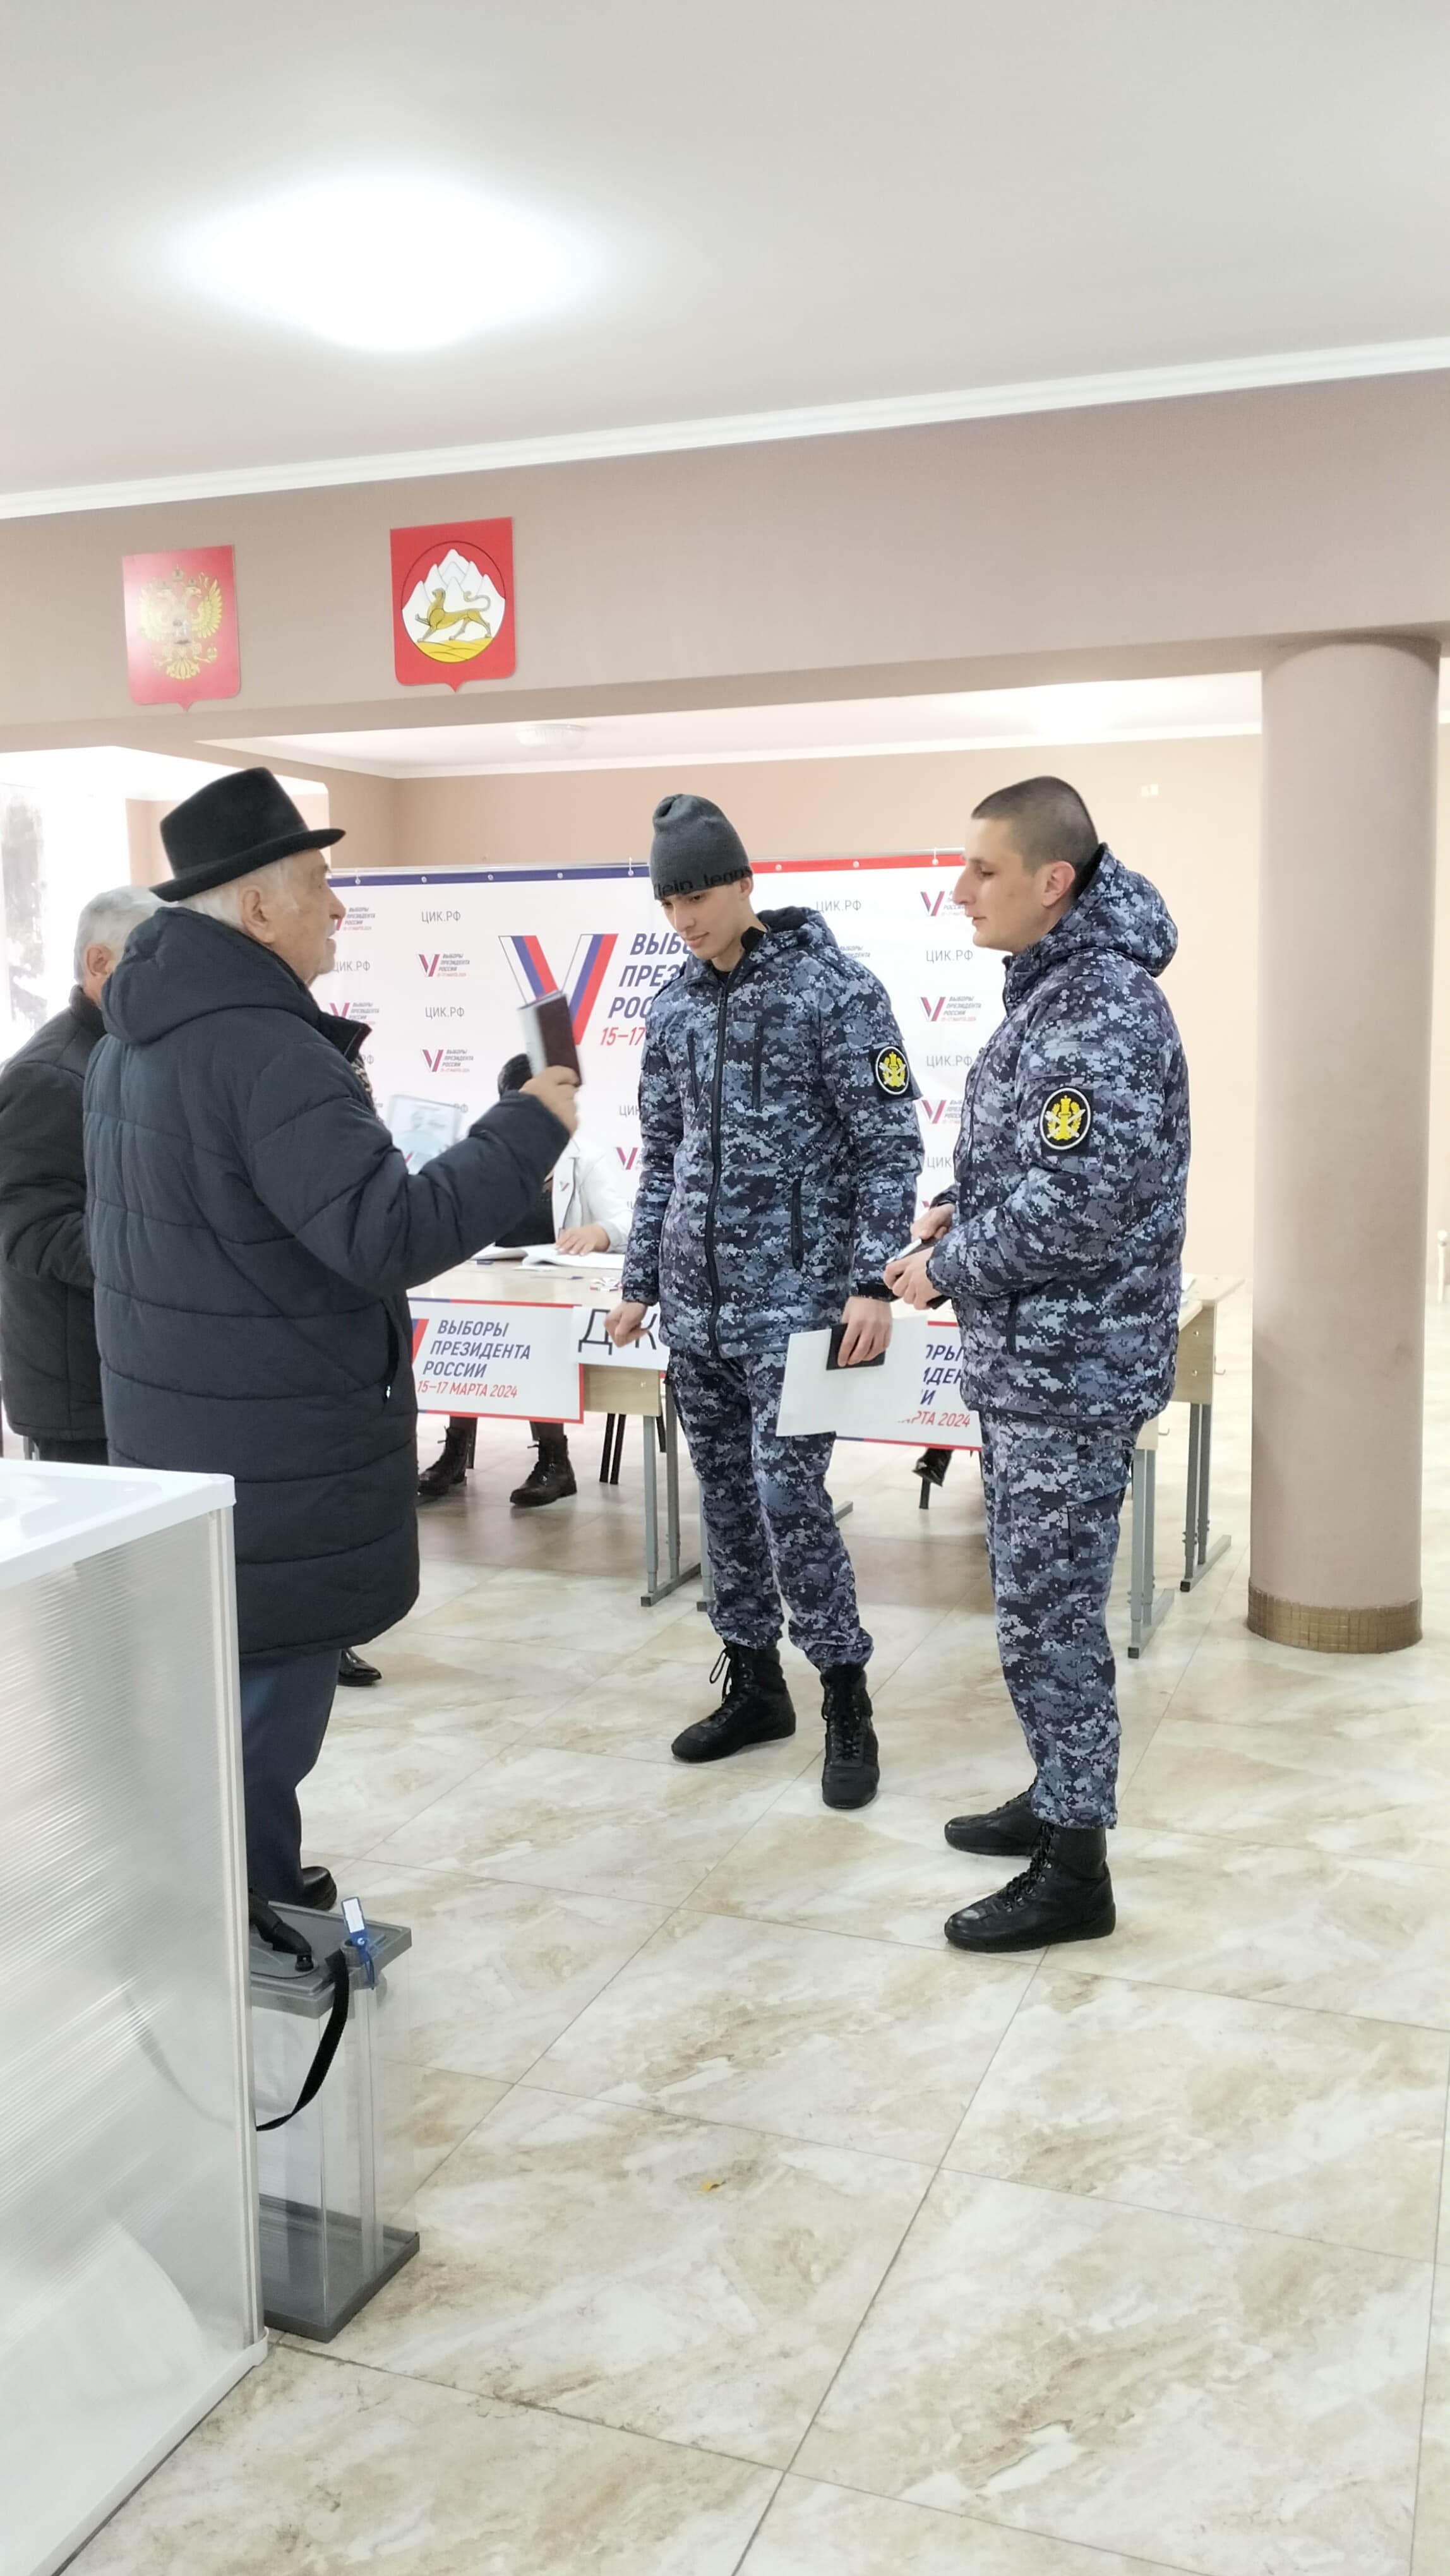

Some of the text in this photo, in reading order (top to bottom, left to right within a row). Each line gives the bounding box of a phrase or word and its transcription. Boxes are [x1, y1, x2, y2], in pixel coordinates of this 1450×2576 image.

[816, 900, 861, 913] ЦИК.РФ
[421, 910, 461, 924] ЦИК.РФ
[926, 950, 973, 963] ЦИК.РФ
[425, 1006, 465, 1020] ЦИК.РФ
[926, 1055, 973, 1068] ЦИК.РФ
[927, 1157, 952, 1169] ЦИК
[437, 1320, 509, 1337] ВЫБОРЫ
[430, 1340, 531, 1360] ПРЕЗИДЕНТА
[422, 1361, 488, 1378] РОССИИ
[450, 1382, 488, 1397] МАРТА
[489, 1385, 518, 1398] 2024
[897, 1410, 971, 1428] РТА 2024
